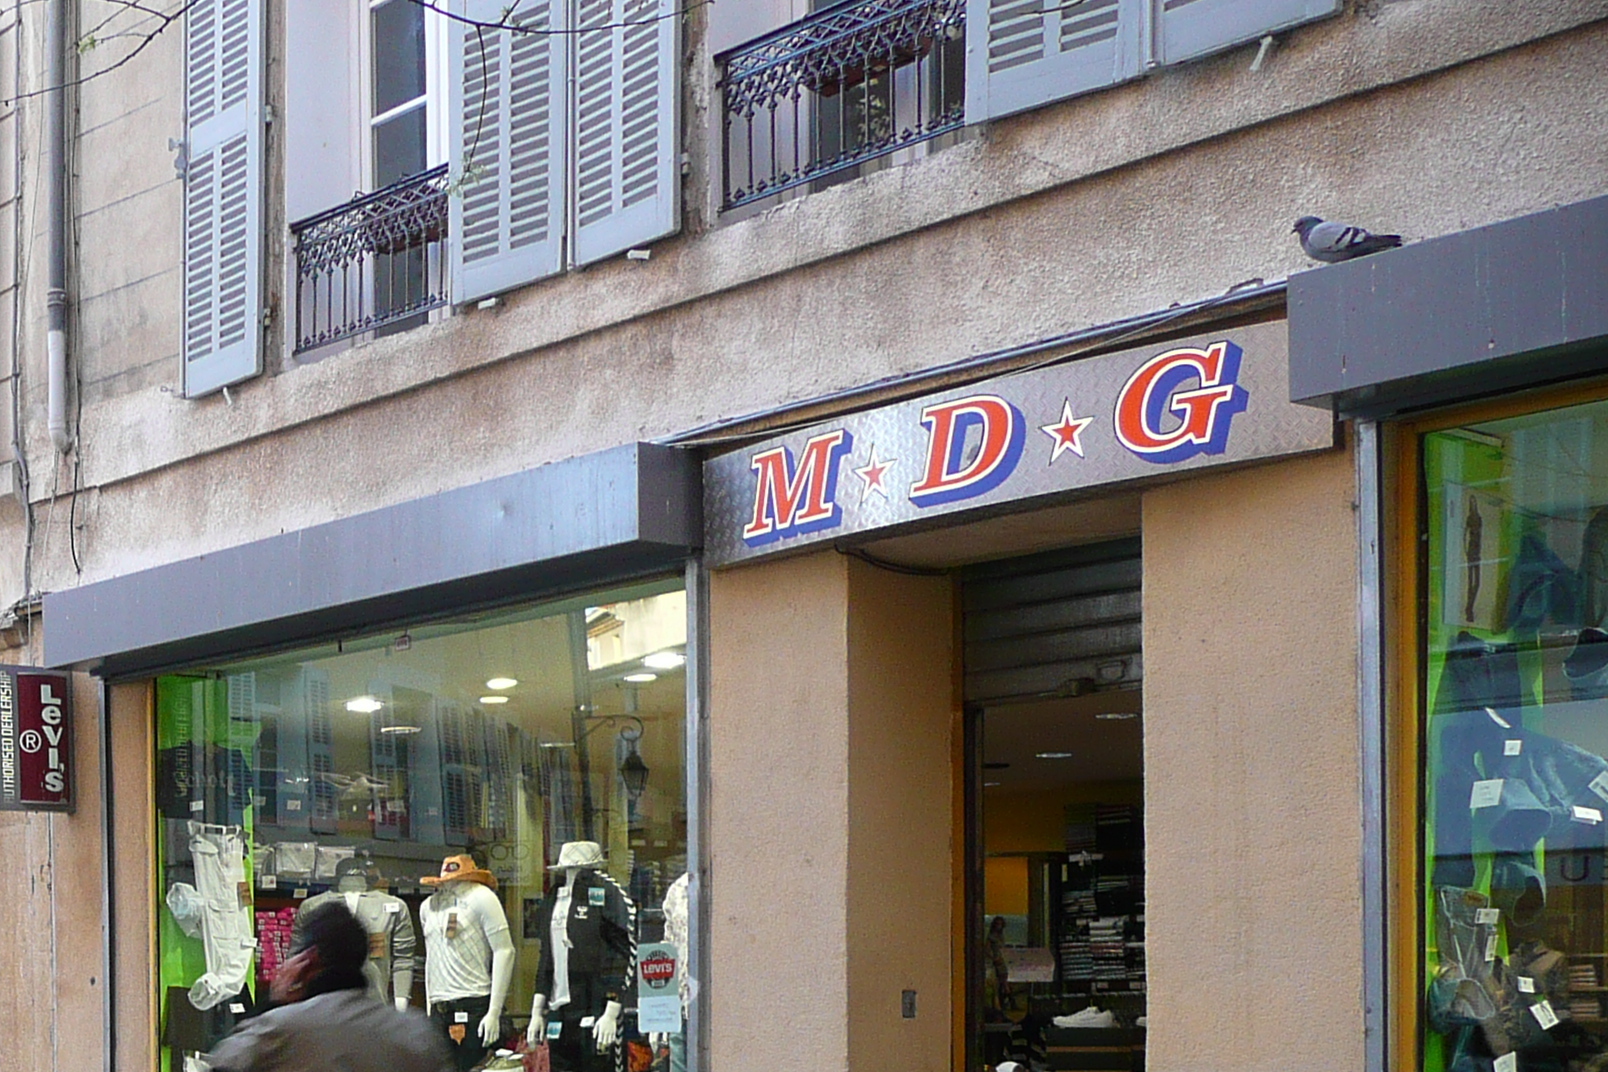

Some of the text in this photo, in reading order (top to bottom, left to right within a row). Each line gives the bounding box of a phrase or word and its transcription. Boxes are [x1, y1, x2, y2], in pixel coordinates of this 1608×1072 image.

[742, 340, 1249, 548] M D G
[0, 670, 16, 802] AUTHORISED DEALERSHIP
